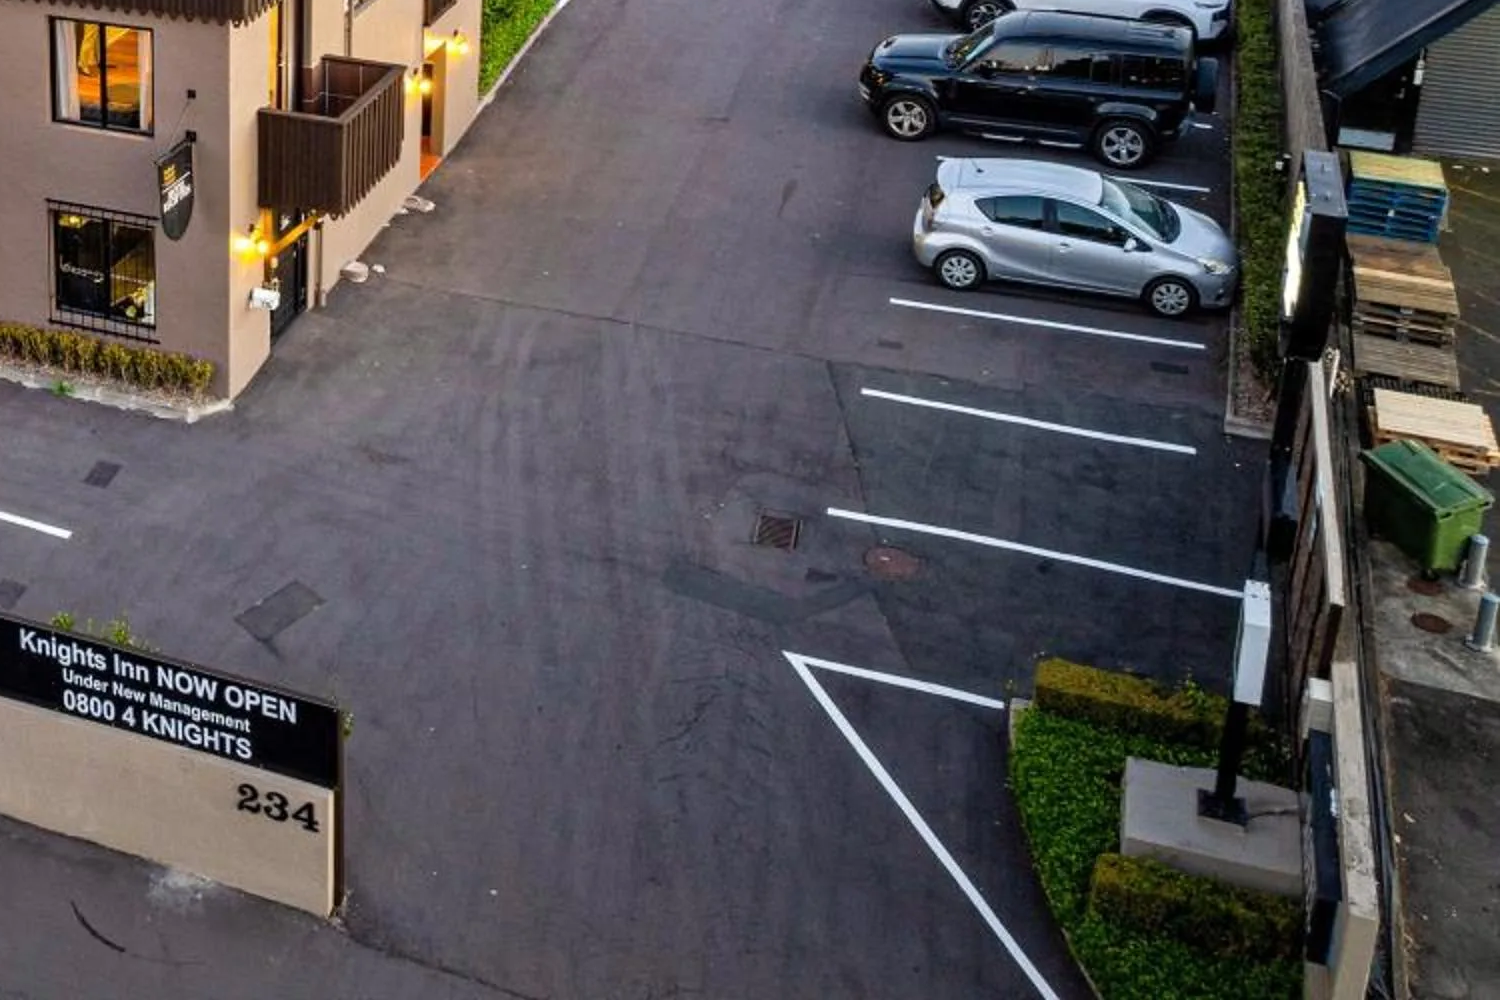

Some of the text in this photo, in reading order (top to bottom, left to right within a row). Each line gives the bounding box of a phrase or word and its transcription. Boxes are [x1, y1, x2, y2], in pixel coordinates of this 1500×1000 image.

[20, 628, 297, 724] Knights Inn NOW OPEN
[62, 668, 251, 733] Under New Management
[63, 689, 252, 760] 0800 4 KNIGHTS
[237, 783, 319, 833] 234
